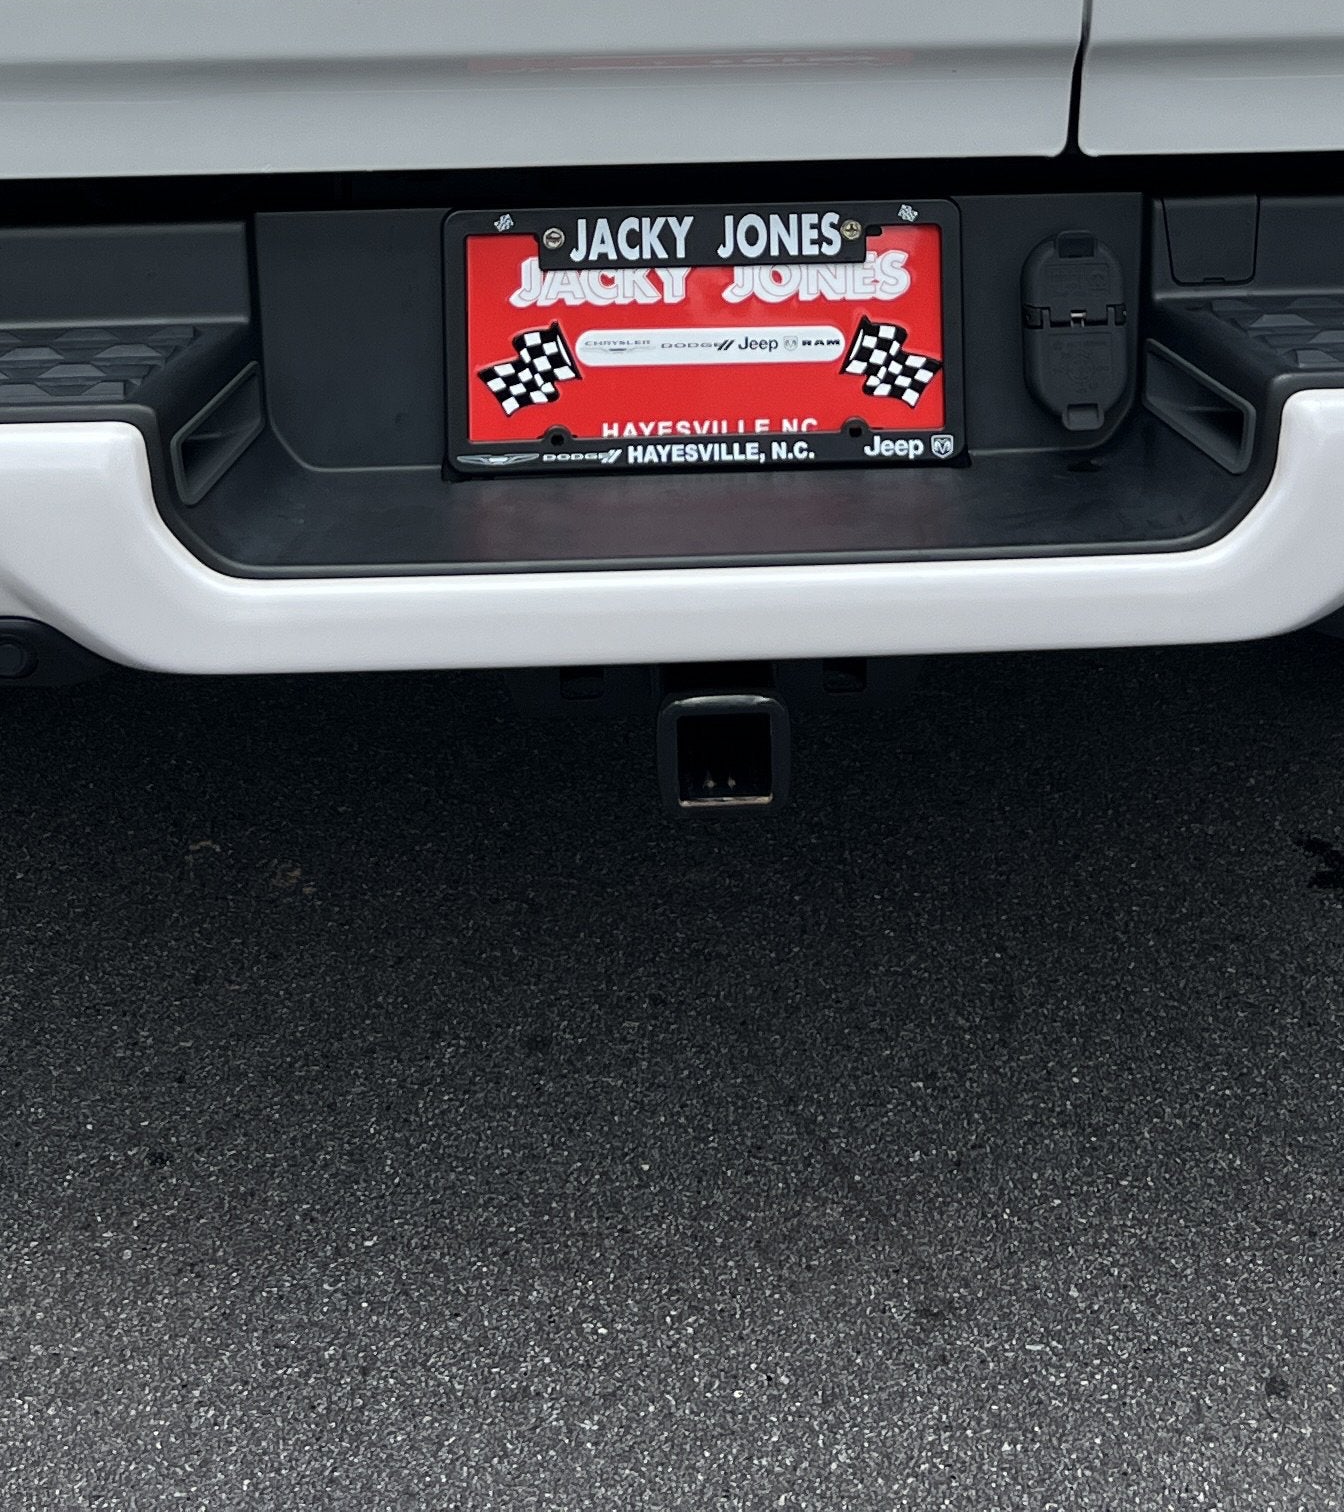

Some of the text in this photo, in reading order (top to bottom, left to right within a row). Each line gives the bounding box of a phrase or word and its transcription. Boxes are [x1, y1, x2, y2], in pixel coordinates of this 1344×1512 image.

[570, 212, 842, 262] JACKY JONES
[509, 250, 910, 308] JACKY JONES
[737, 336, 779, 352] Jeep
[801, 339, 841, 347] RAM
[627, 441, 766, 465] HAYESVILLE,
[772, 440, 816, 461] N.C.
[863, 435, 923, 459] Jeep
